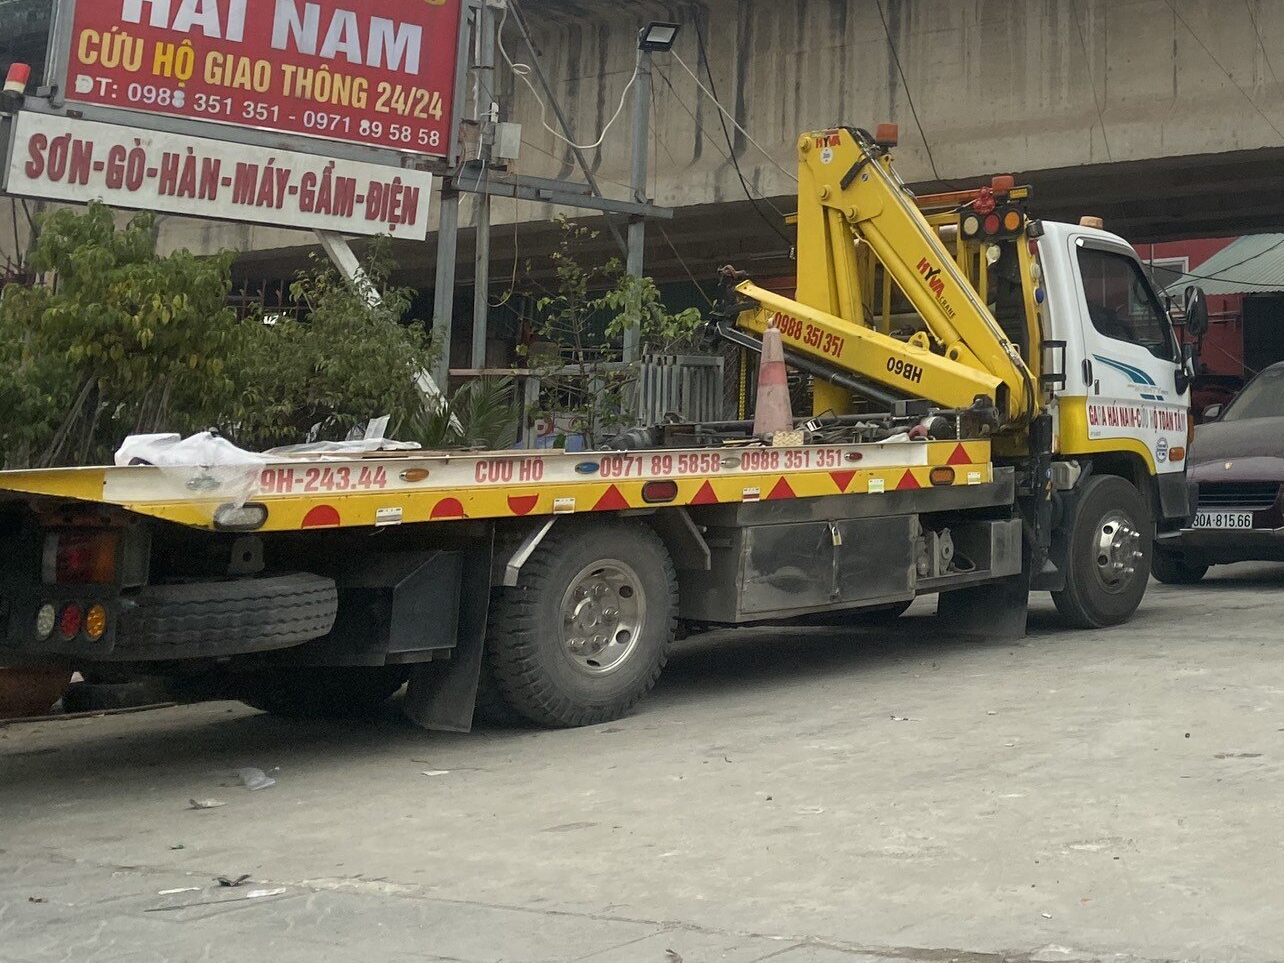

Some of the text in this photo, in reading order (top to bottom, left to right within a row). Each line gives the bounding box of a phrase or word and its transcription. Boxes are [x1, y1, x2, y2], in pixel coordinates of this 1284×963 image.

[77, 26, 443, 122] CỨU HỘ GIAO THÔNG 24/24
[75, 73, 118, 99] ĐT:
[127, 83, 186, 109] 0988
[193, 94, 233, 115] 351
[242, 100, 280, 123] 351
[303, 110, 351, 134] 0971
[359, 119, 383, 139] 89
[389, 124, 412, 143] 58
[418, 130, 441, 147] 58
[815, 134, 842, 149] HYVA
[916, 256, 957, 318] HYVA CRANE
[772, 311, 846, 359] 0988 351 351
[887, 356, 923, 384] HB60
[599, 448, 843, 478] 0971 89 5858 0988 351 351
[1193, 513, 1251, 528] 30A-815.66
